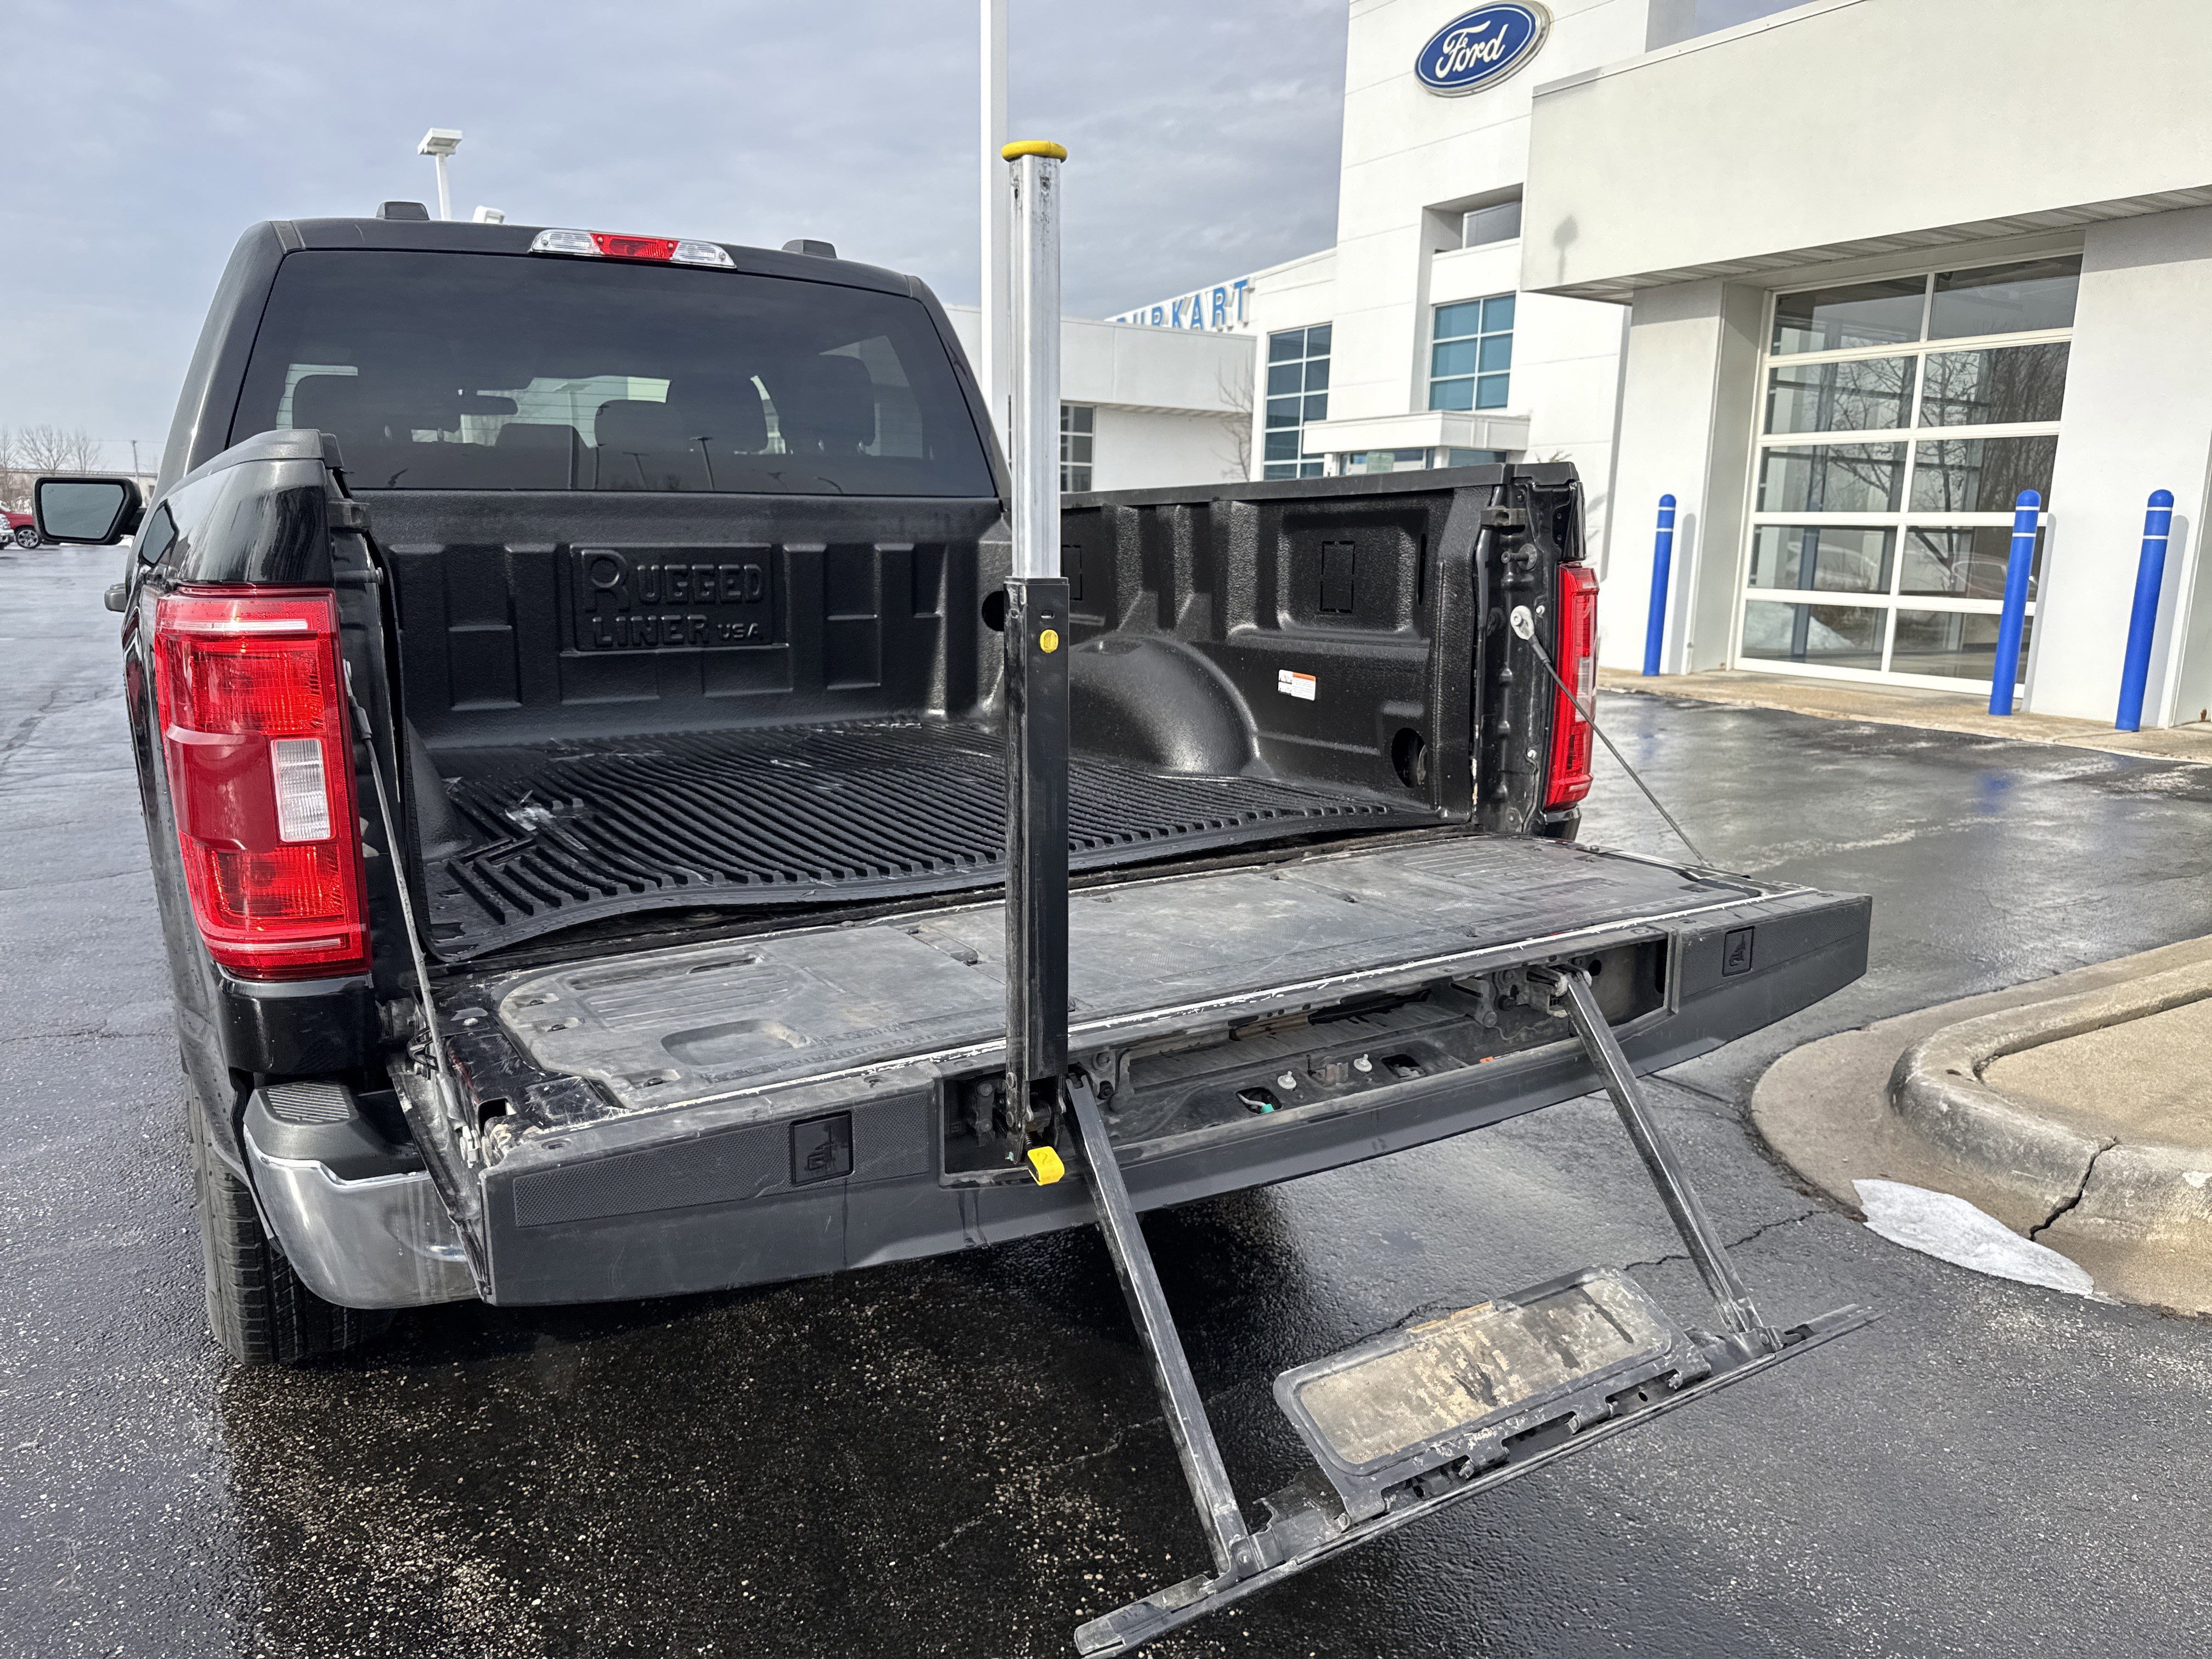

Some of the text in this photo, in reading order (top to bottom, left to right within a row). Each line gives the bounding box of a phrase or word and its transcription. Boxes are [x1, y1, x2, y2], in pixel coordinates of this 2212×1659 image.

[1435, 20, 1509, 79] Ford
[1116, 279, 1249, 330] URKART
[582, 549, 764, 613] RUGGED
[592, 615, 764, 648] LINER USA
[1037, 1151, 1053, 1165] 2
